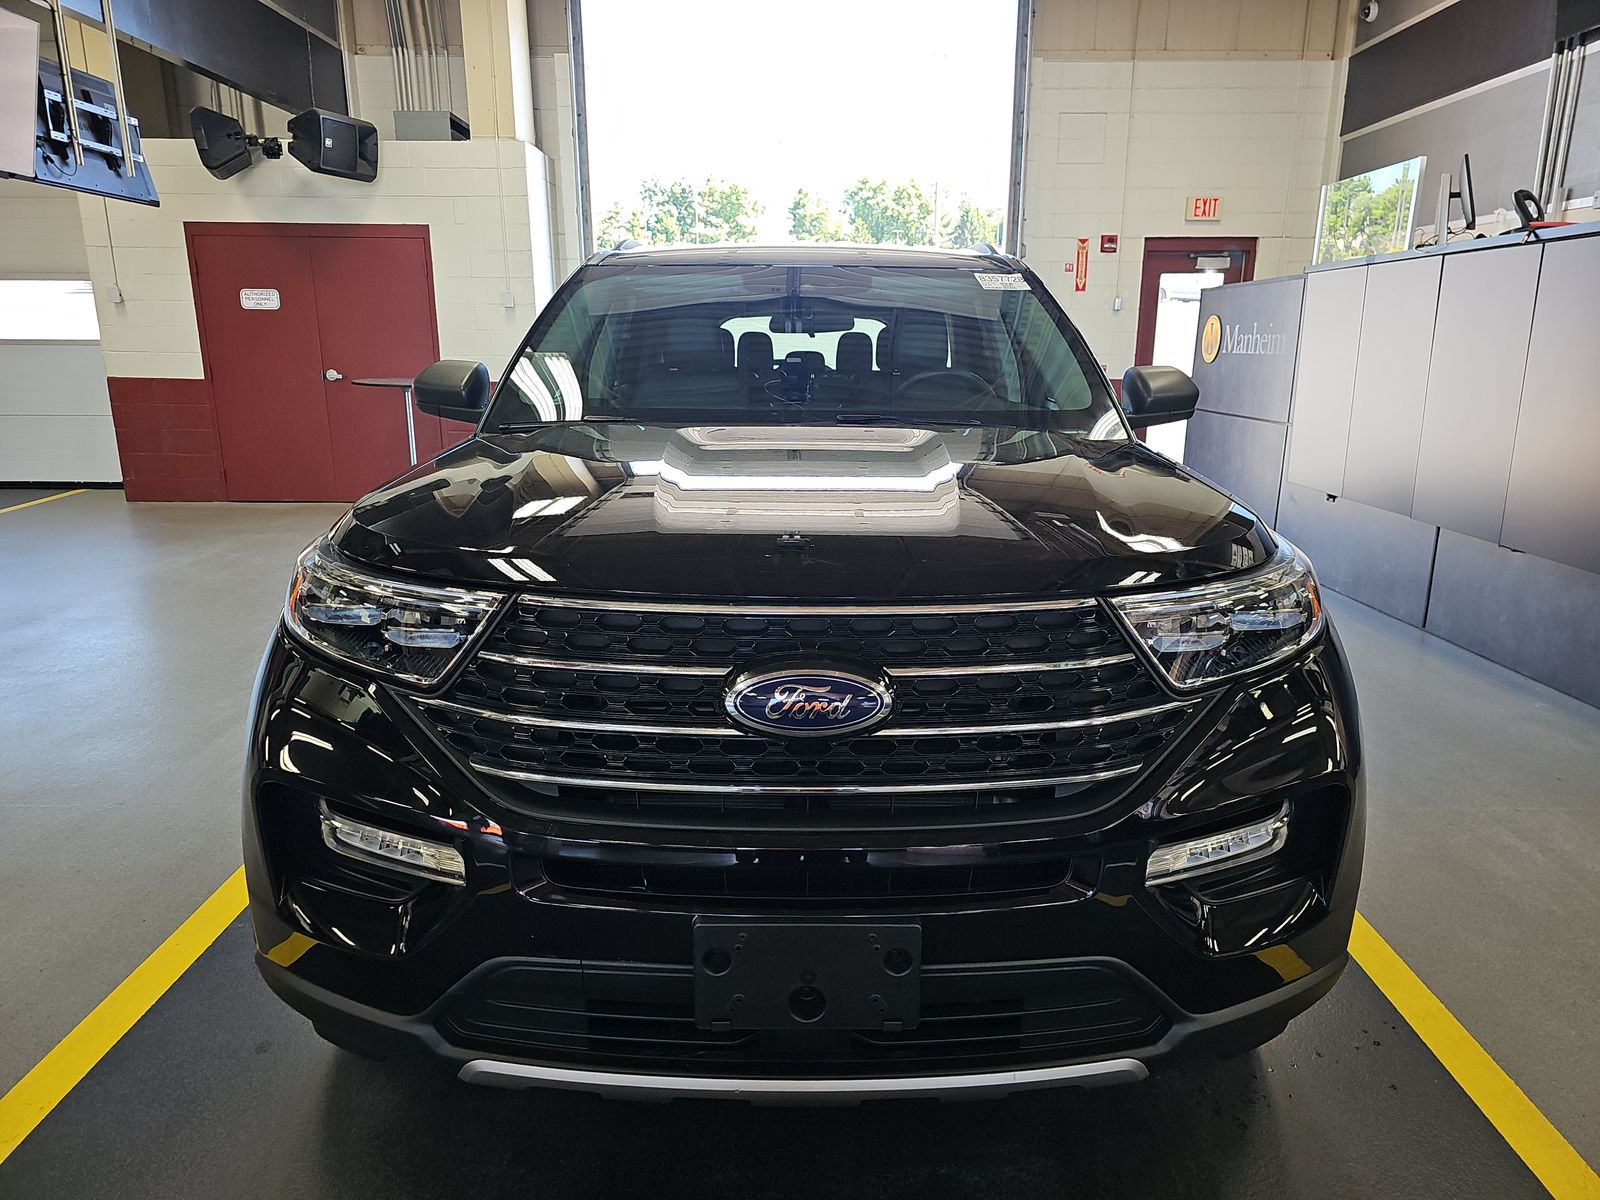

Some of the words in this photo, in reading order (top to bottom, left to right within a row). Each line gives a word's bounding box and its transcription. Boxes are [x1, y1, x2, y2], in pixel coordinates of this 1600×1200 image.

[1194, 198, 1219, 217] EXIT
[1222, 322, 1286, 354] Manheim
[766, 684, 853, 720] Ford
